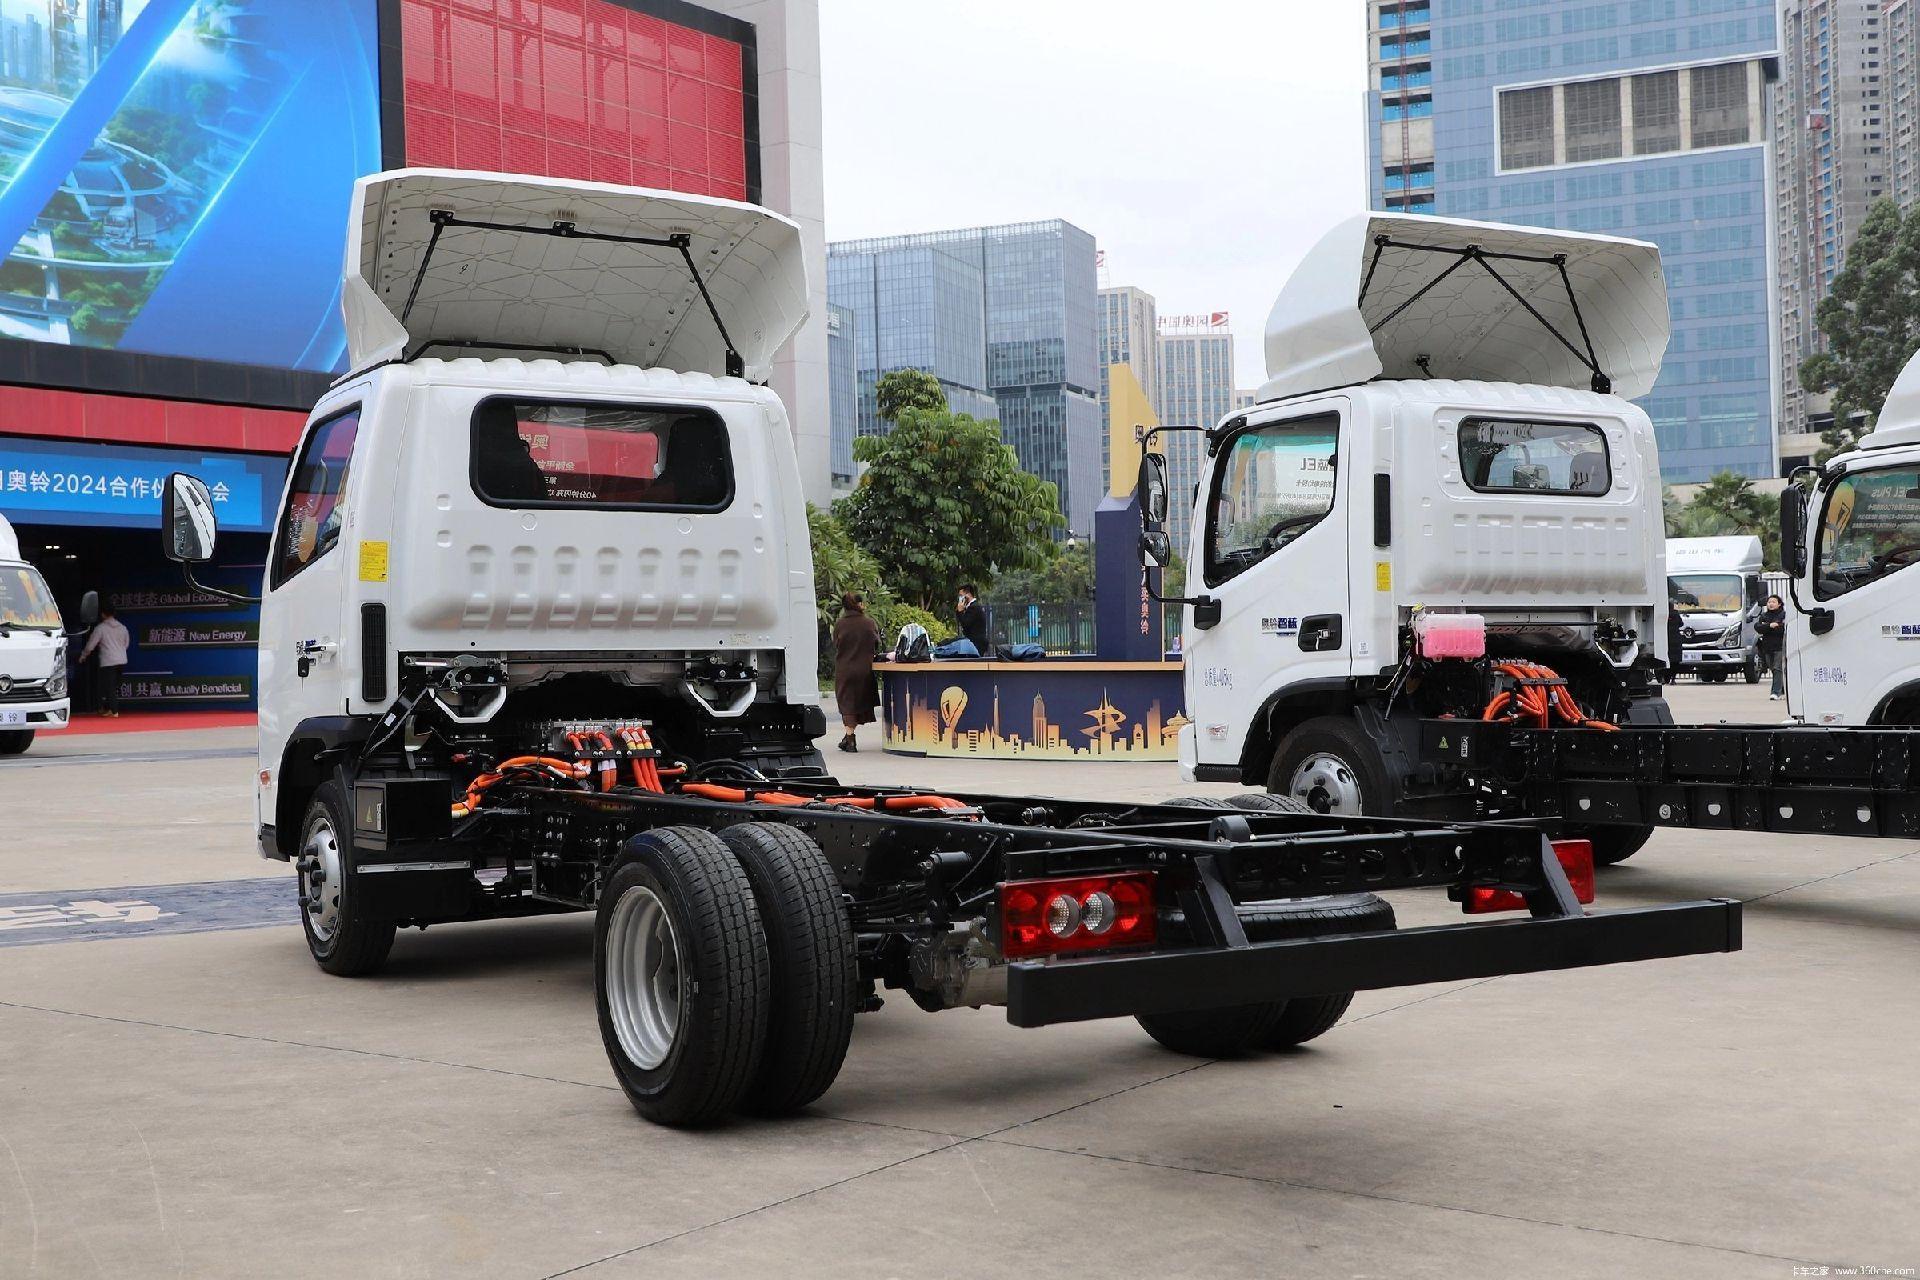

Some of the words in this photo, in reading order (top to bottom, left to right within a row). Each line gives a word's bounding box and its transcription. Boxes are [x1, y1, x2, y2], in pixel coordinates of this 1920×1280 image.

[160, 592, 190, 603] Global
[150, 628, 186, 642] 新能源
[190, 631, 210, 640] New
[212, 630, 246, 642] Energy
[166, 685, 200, 695] Mutually
[202, 683, 241, 694] Beneficial
